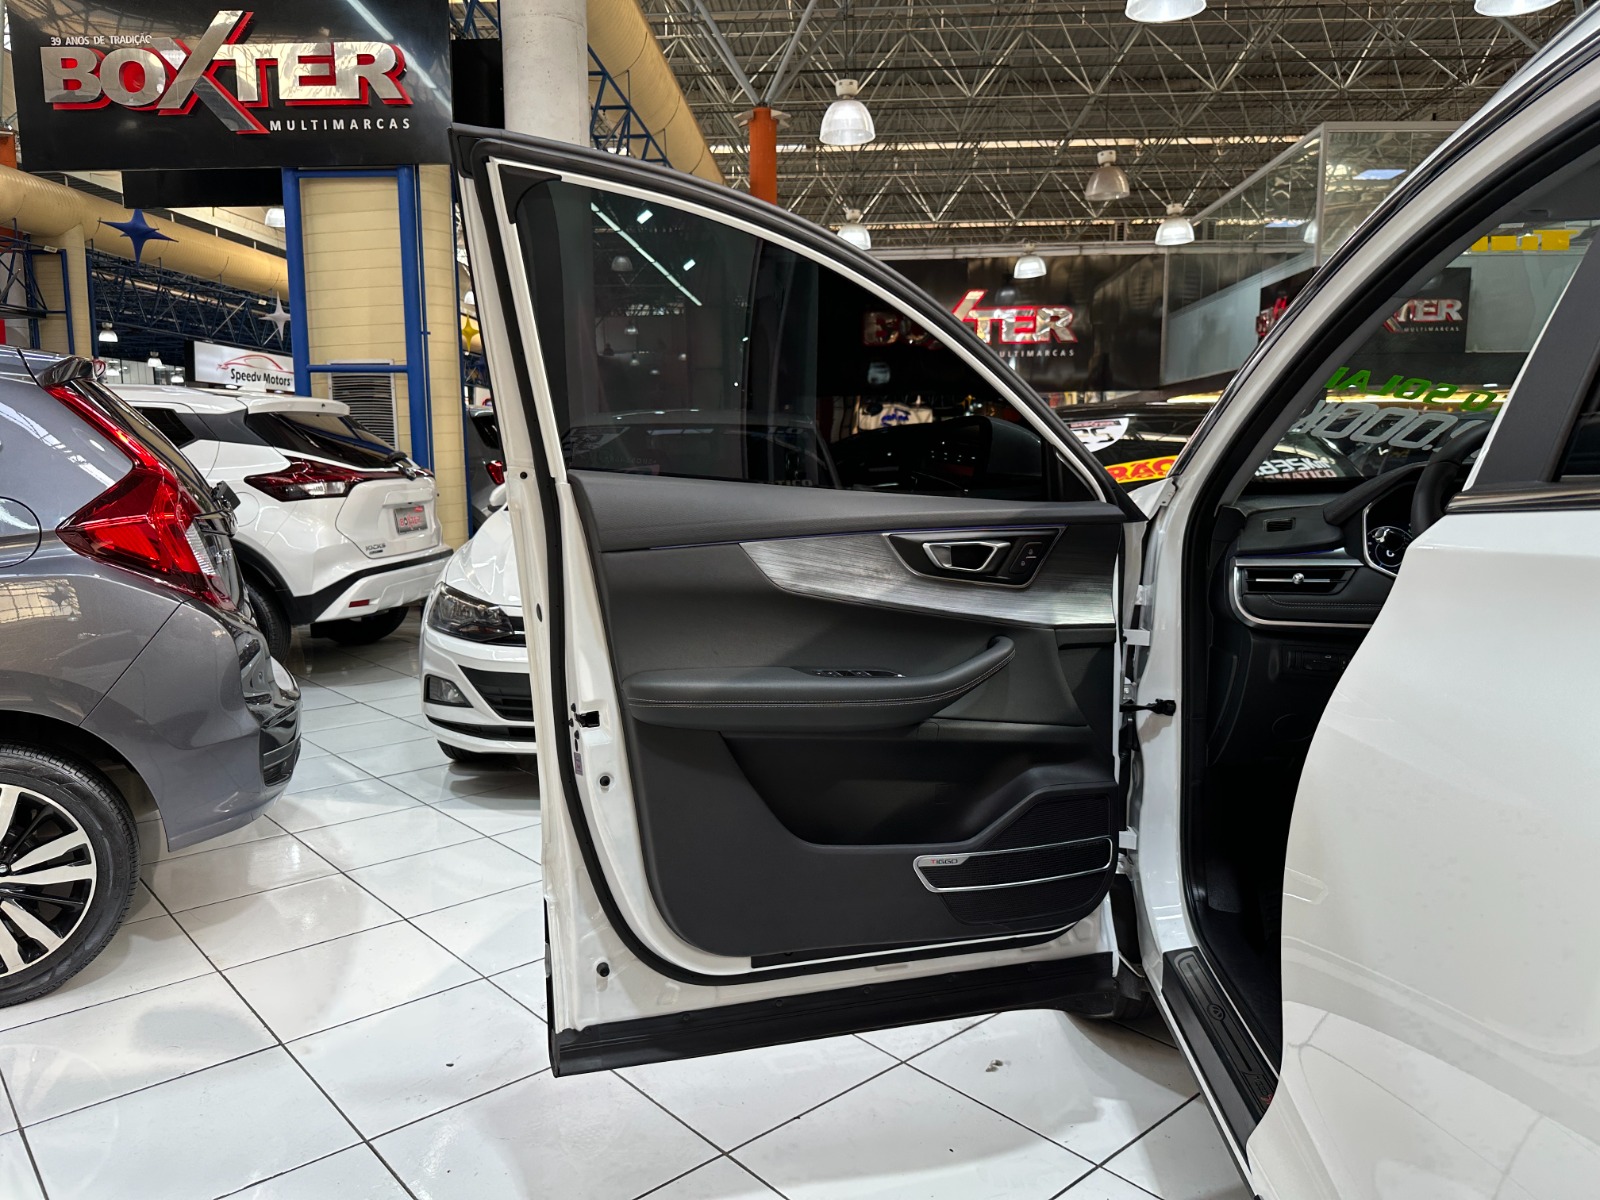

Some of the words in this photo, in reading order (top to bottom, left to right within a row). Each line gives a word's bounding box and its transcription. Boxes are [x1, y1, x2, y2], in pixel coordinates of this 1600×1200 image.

[50, 37, 61, 46] 39
[65, 36, 90, 46] ANOS
[94, 35, 105, 45] DE
[109, 32, 153, 46] TRADIÇÃO
[40, 10, 413, 134] BOXTER
[269, 118, 411, 131] MULTIMARCAS
[1403, 325, 1460, 333] MULTIMARCAS
[998, 348, 1075, 358] ULTIMARCAS
[263, 372, 291, 386] Motors
